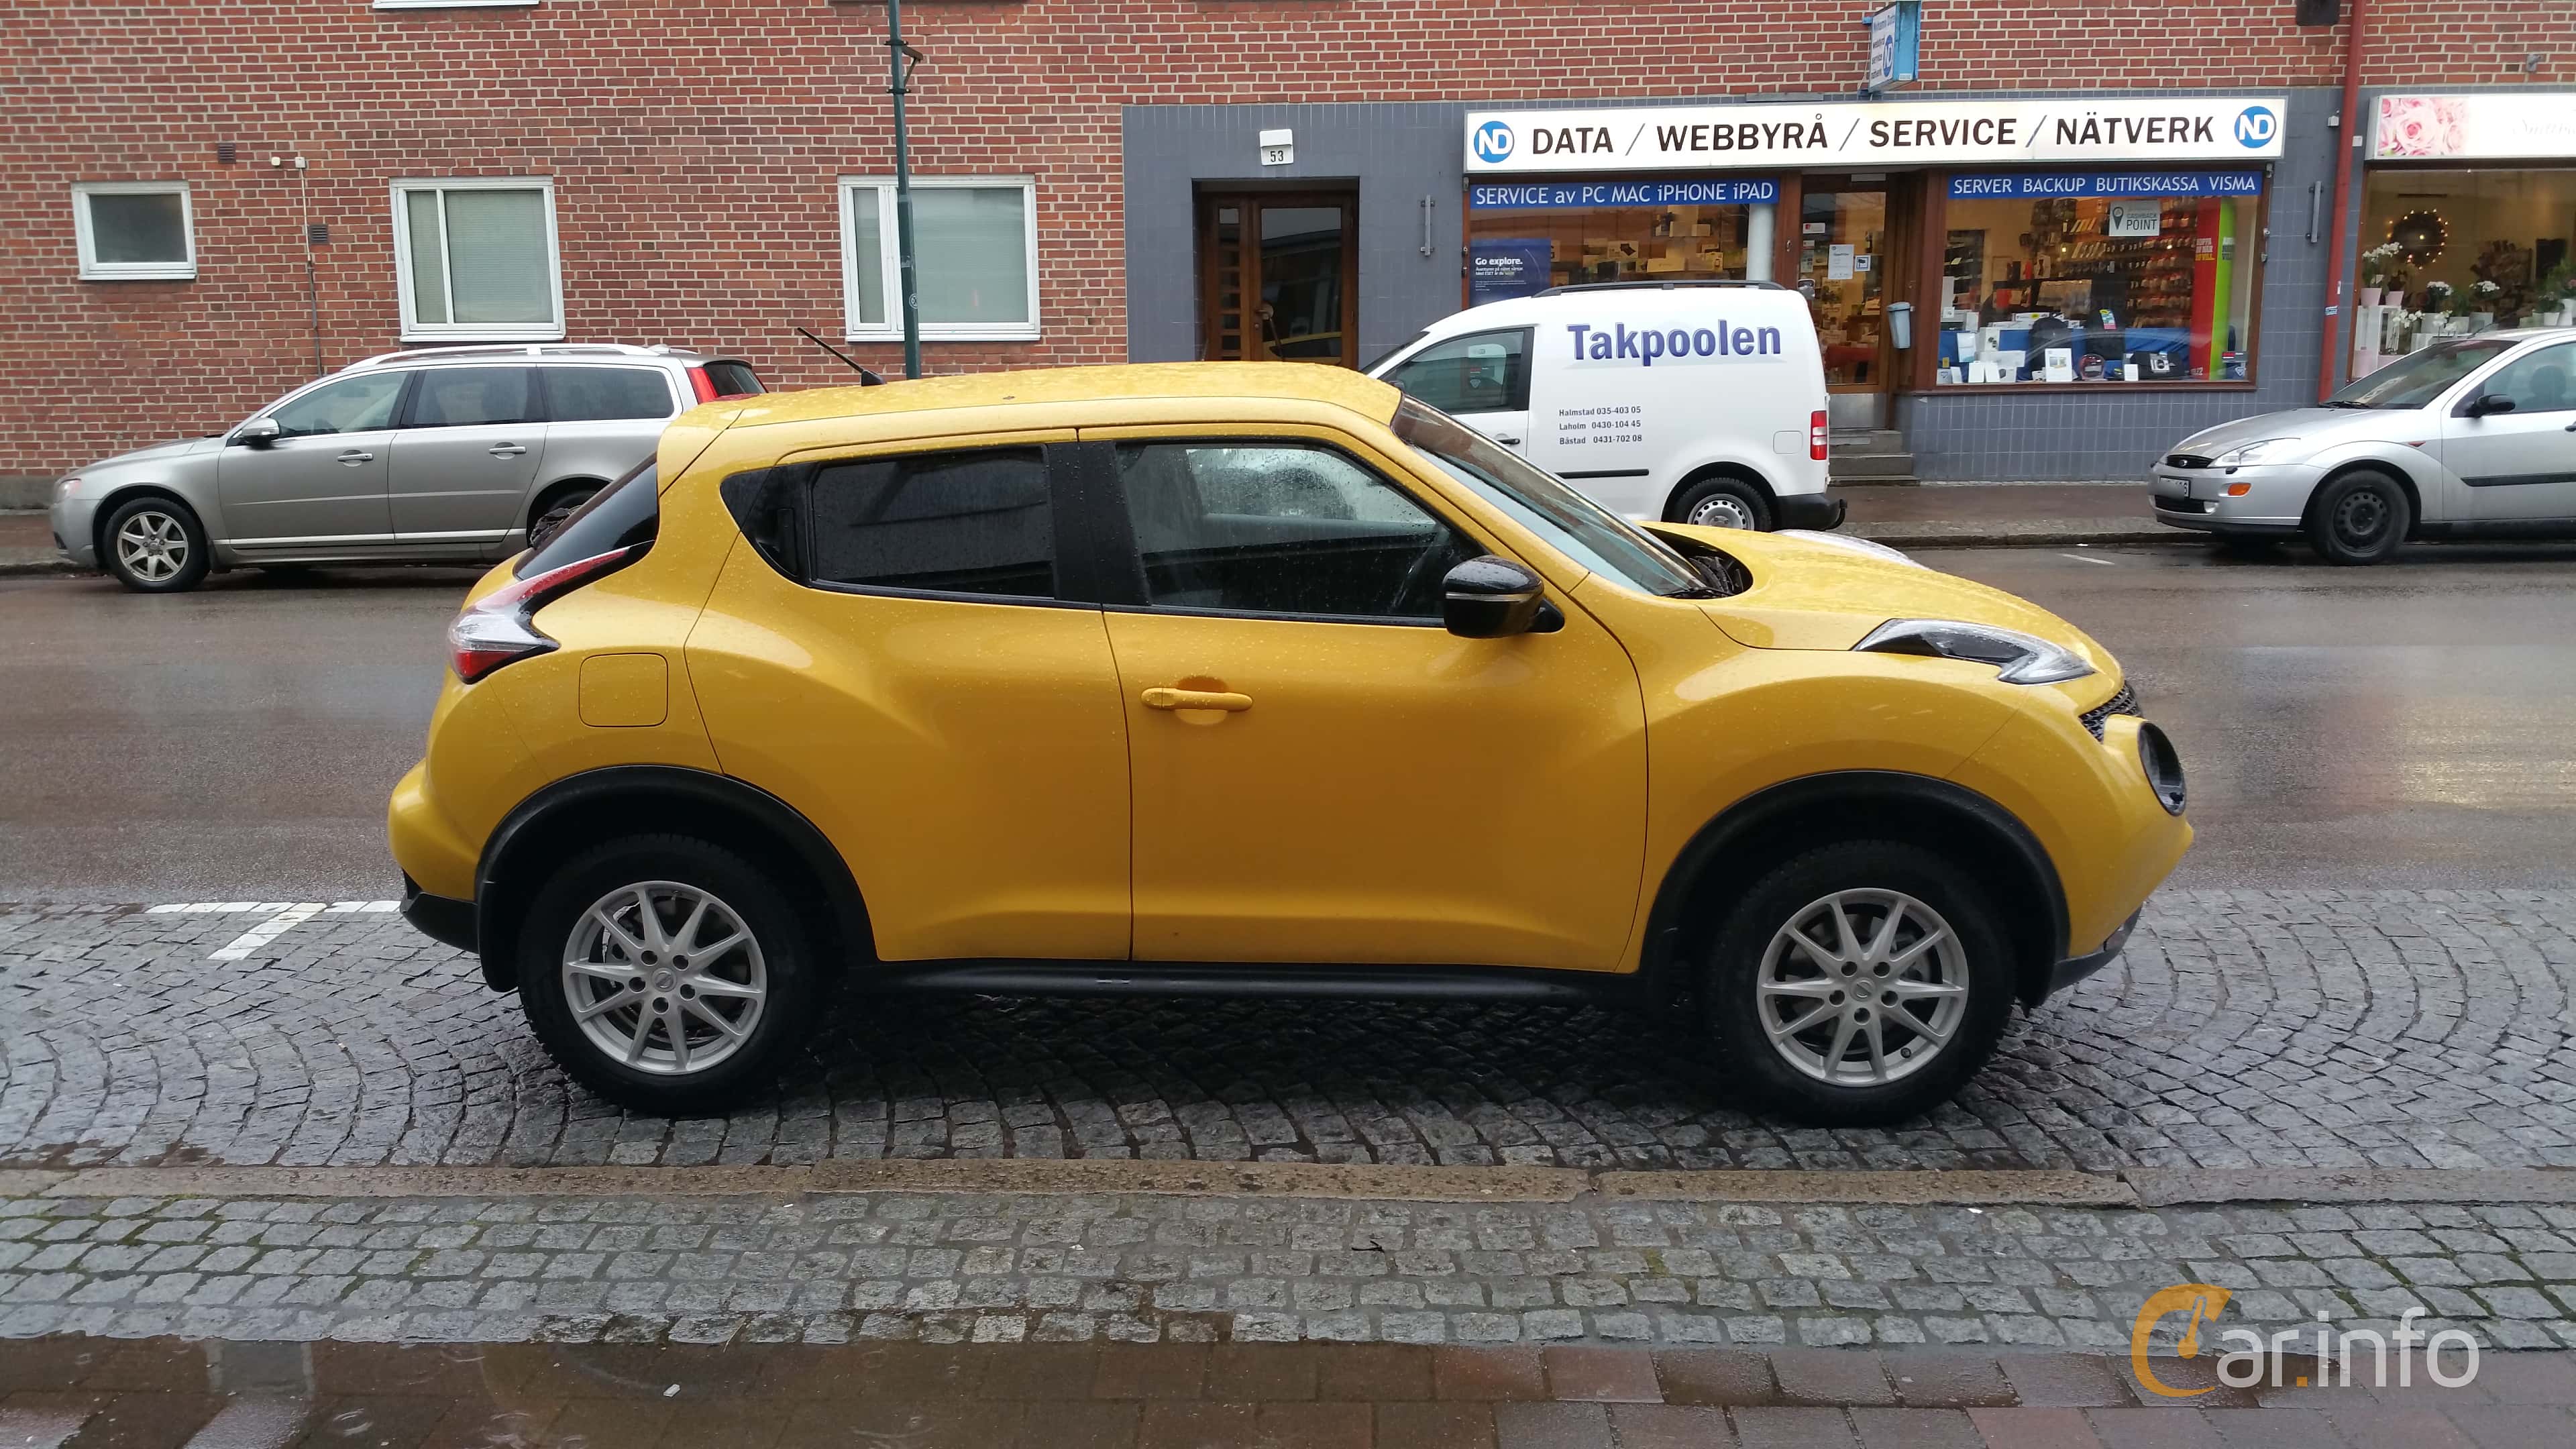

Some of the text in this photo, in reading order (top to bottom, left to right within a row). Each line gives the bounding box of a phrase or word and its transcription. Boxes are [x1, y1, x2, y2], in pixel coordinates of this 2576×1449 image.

[1532, 127, 1614, 155] DATA
[1656, 113, 1829, 152] WEBBYRÅ
[1869, 118, 2017, 148] SERVICE
[2055, 111, 2214, 145] NÄTVERK
[2238, 114, 2275, 141] ND
[1478, 129, 1514, 156] ND
[1270, 150, 1284, 162] 53
[1953, 176, 2255, 194] SERVER BACKUP BUTIKSKASSA VISMA
[1476, 184, 1773, 205] SERVICE av PC MAC iPHONE iPAD
[2127, 219, 2159, 231] POINT
[1489, 258, 1523, 266] explore.
[1566, 319, 1782, 367] Takpoolen
[1559, 408, 1595, 416] Halmstad
[1597, 407, 1629, 415] 035-403
[1592, 421, 1629, 429] 0430-104
[1559, 434, 1642, 445] Båstad 0431-702 08
